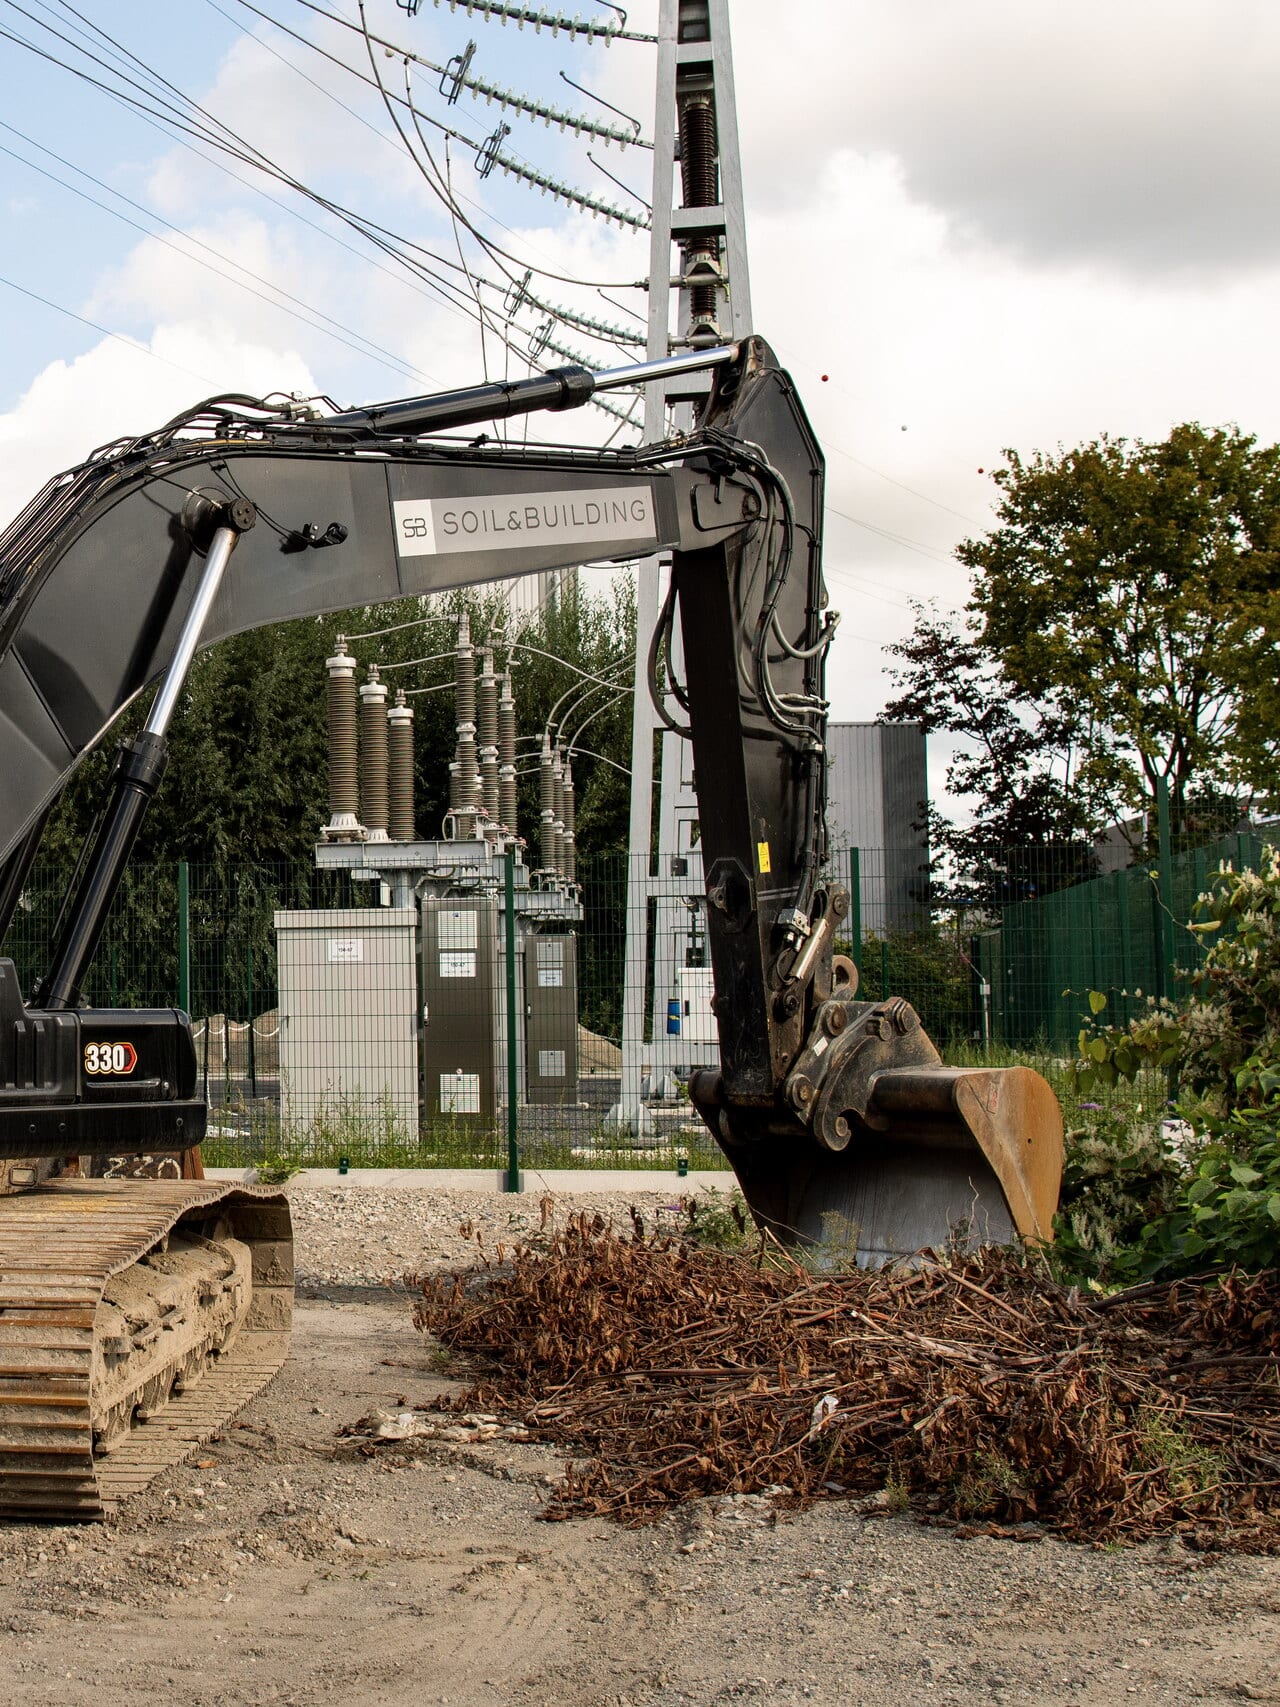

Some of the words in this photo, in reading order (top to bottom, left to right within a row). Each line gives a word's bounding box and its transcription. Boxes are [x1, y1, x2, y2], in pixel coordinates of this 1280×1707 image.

[402, 517, 428, 539] SB
[442, 499, 646, 536] SOIL&BUILDING
[86, 1044, 125, 1071] 330
